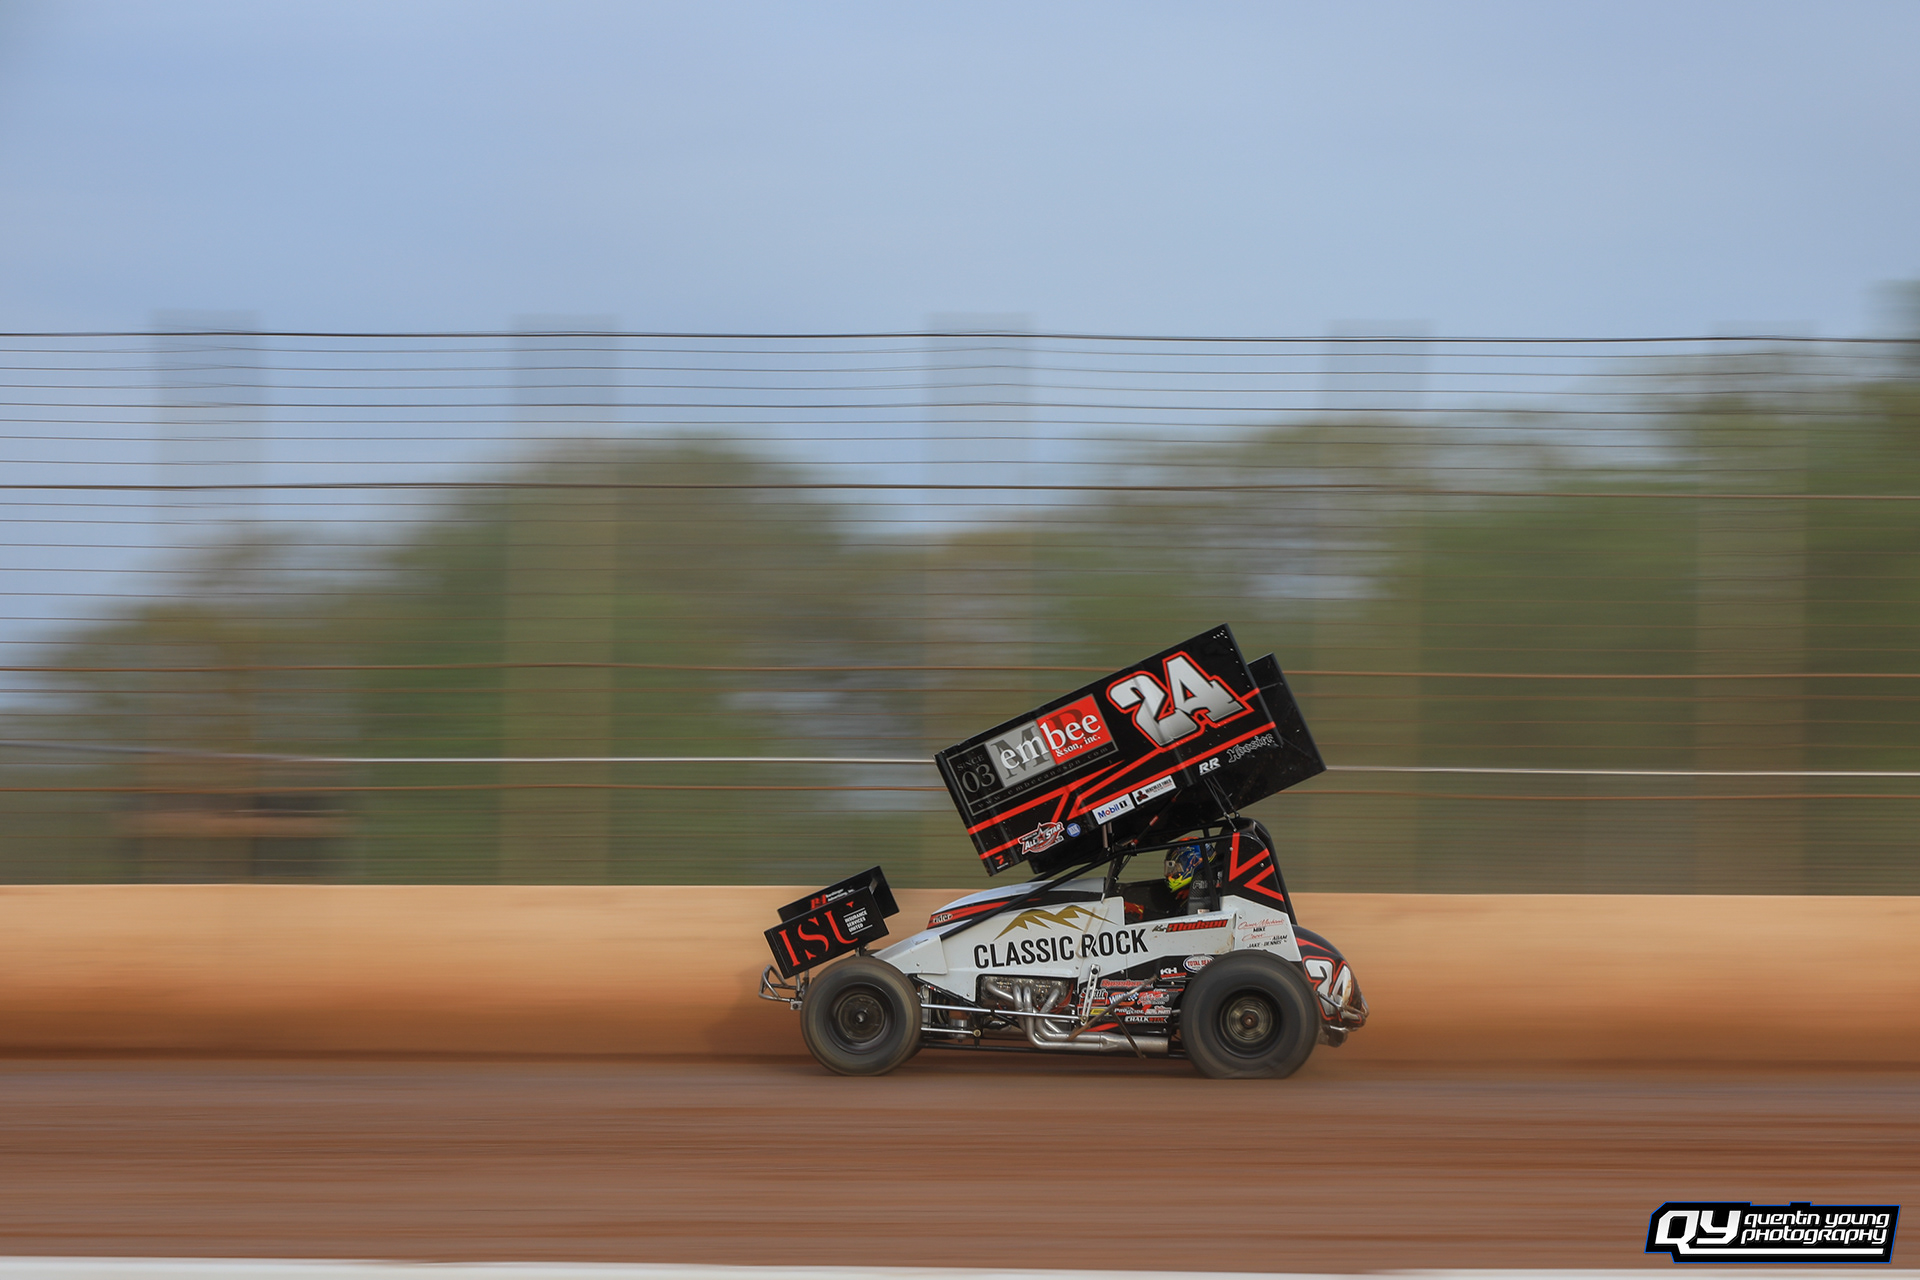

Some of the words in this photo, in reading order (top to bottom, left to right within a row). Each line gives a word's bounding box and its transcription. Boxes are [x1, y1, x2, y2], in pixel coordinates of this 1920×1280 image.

[1108, 653, 1246, 749] 24
[1000, 713, 1101, 770] embee
[1083, 734, 1101, 745] inc.
[957, 754, 985, 771] SINCE
[1199, 757, 1221, 775] RR
[962, 764, 996, 793] 03
[1097, 804, 1120, 819] Mobil
[1045, 824, 1061, 839] STAR
[844, 909, 868, 923] INSURANCE
[846, 916, 866, 928] SERVICES
[848, 923, 864, 933] UNITED
[974, 935, 1075, 969] CLASSIC
[1081, 928, 1149, 958] ROCK
[1305, 959, 1361, 1019] 24
